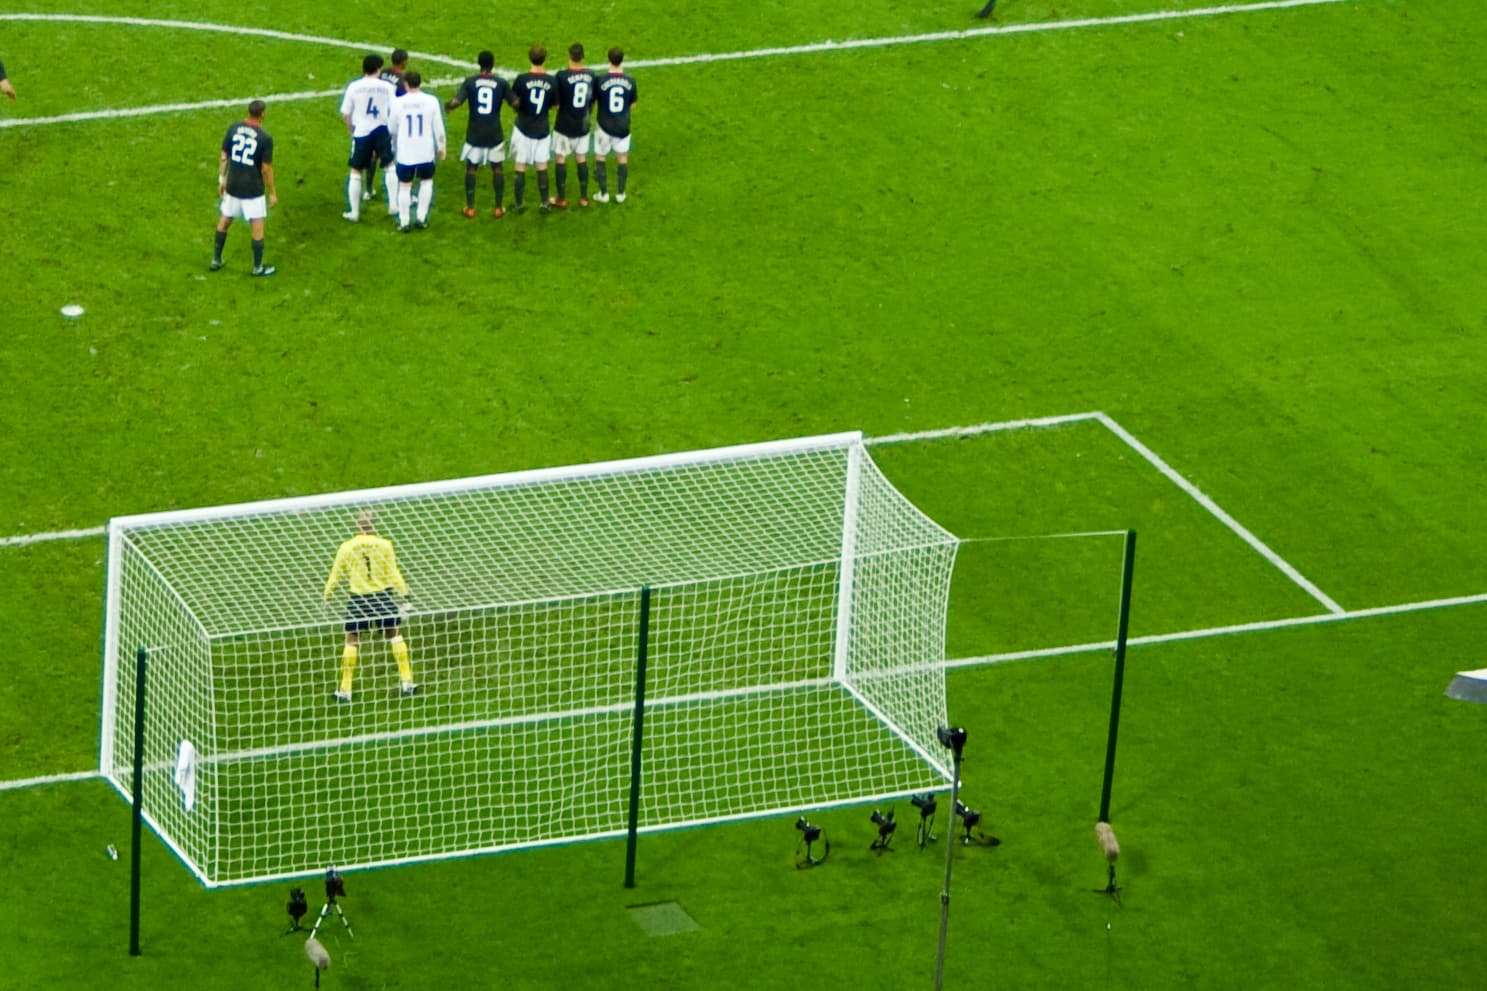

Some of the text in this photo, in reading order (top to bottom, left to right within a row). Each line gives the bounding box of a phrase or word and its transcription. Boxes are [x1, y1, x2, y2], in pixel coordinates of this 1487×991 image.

[366, 97, 379, 118] 4
[478, 88, 493, 114] 9
[530, 88, 544, 114] 4
[573, 83, 587, 108] 8
[609, 87, 624, 113] 6
[406, 114, 423, 137] 11
[232, 134, 256, 165] 22
